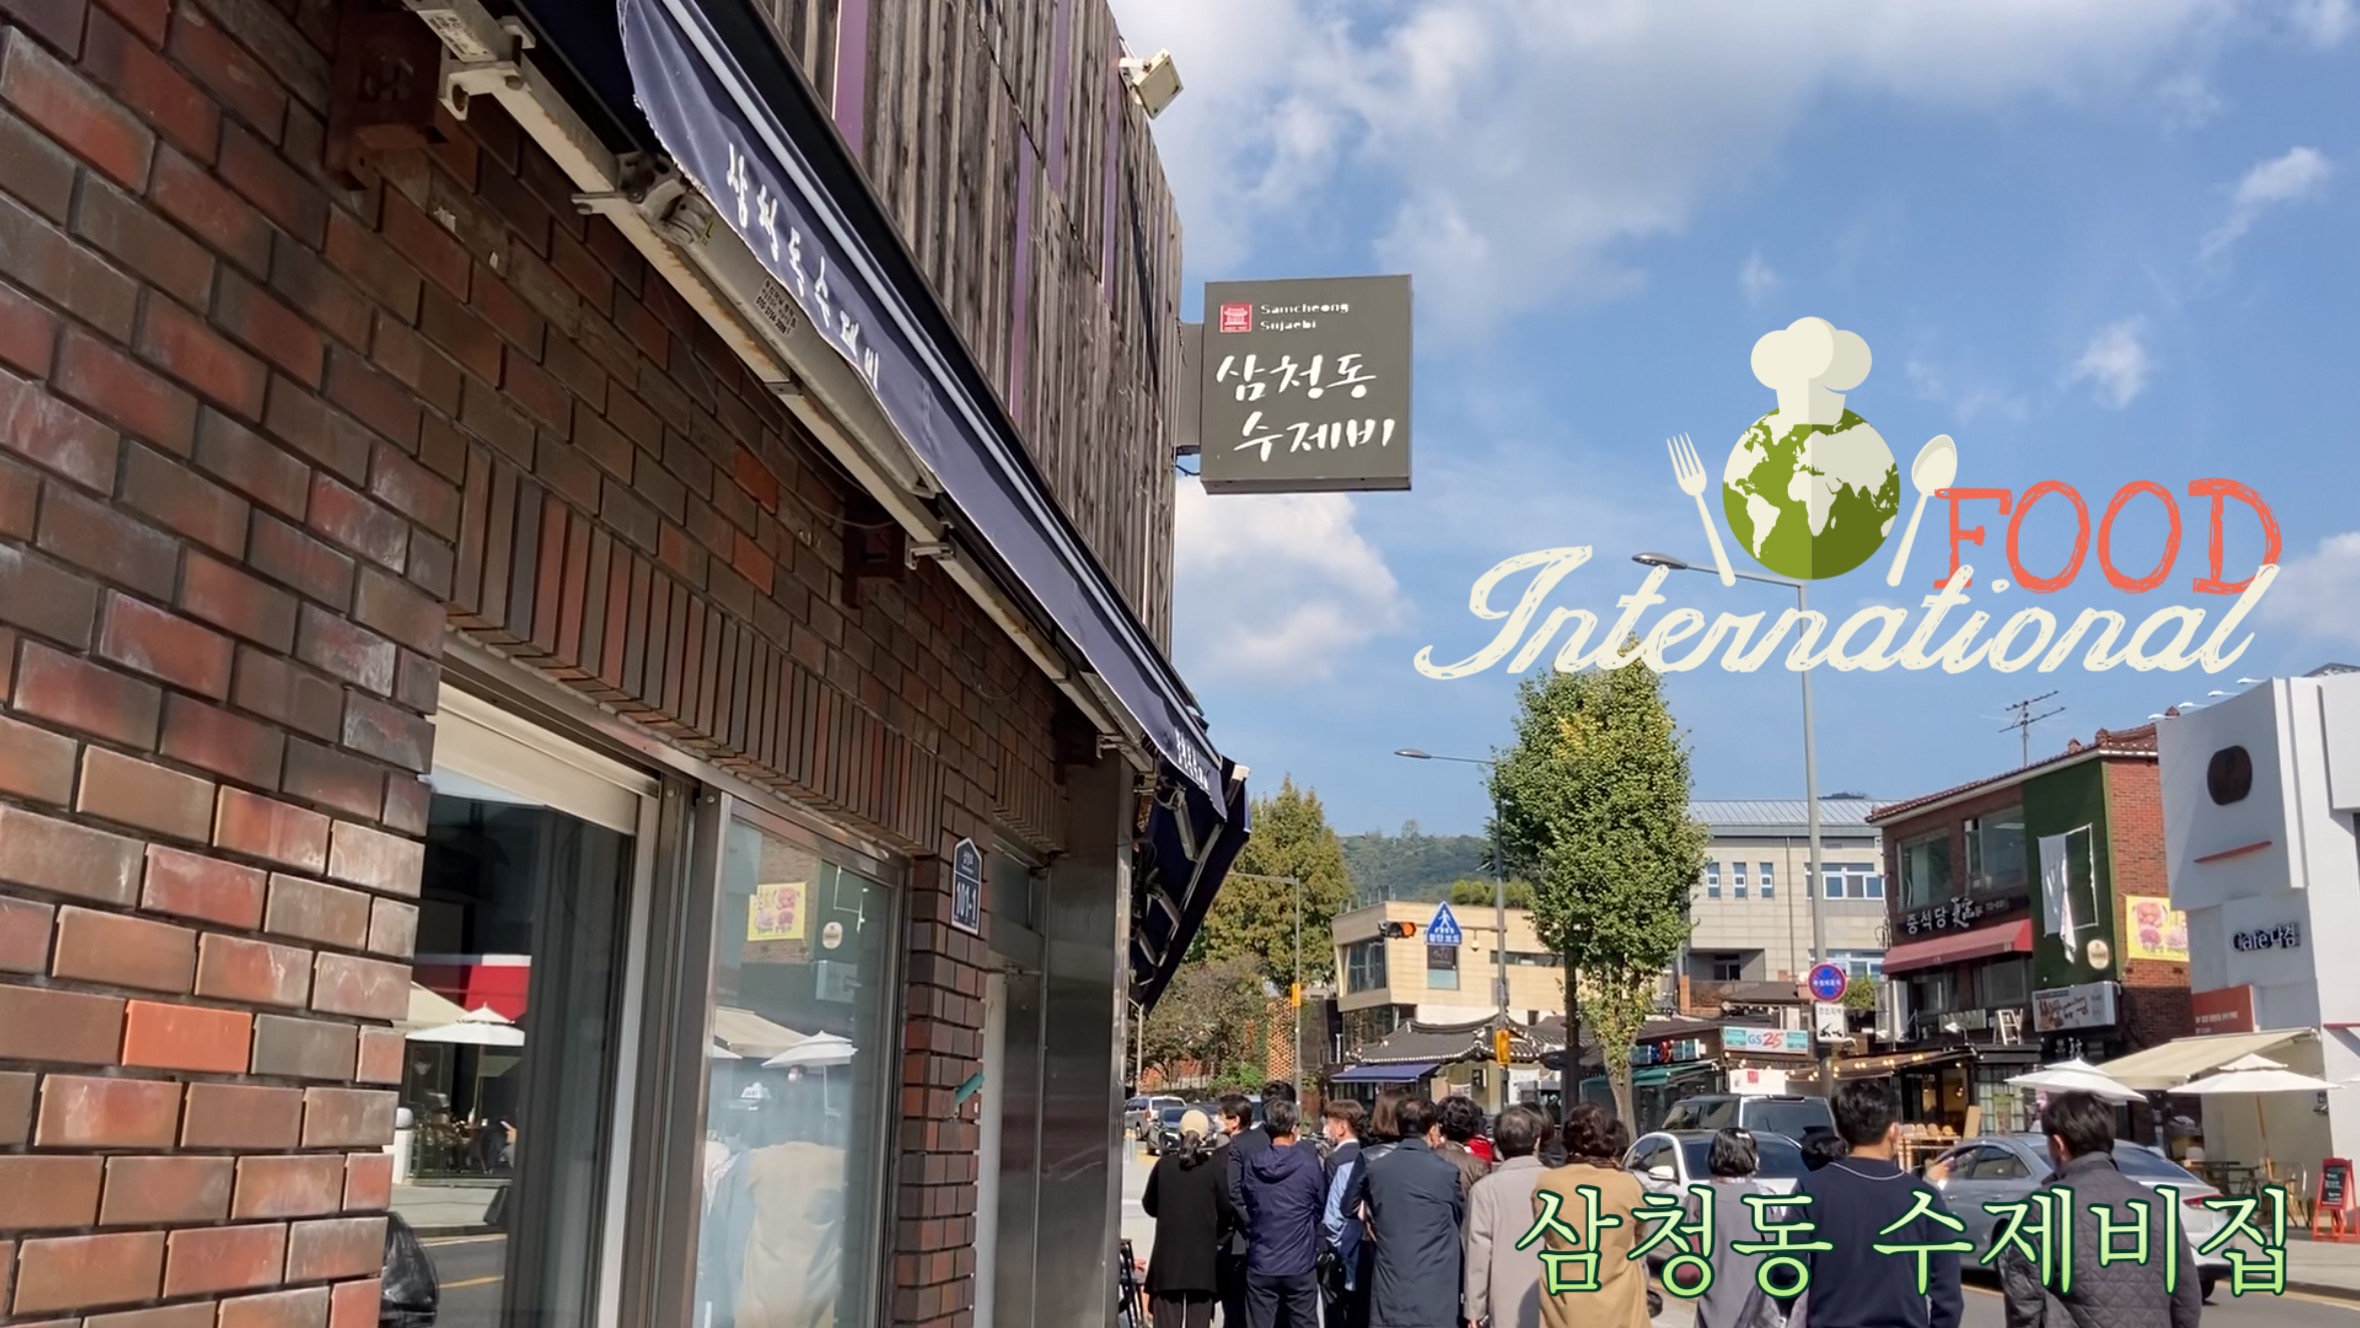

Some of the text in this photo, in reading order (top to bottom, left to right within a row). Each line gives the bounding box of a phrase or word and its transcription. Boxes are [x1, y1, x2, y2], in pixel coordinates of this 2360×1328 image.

[1260, 302, 1350, 315] Samcheong
[1260, 319, 1316, 332] Sujaebi
[1216, 352, 1377, 402] 삼청동
[1233, 410, 1395, 463] 수제비
[1906, 906, 1948, 935] 중식당
[1747, 1031, 1785, 1049] GS25
